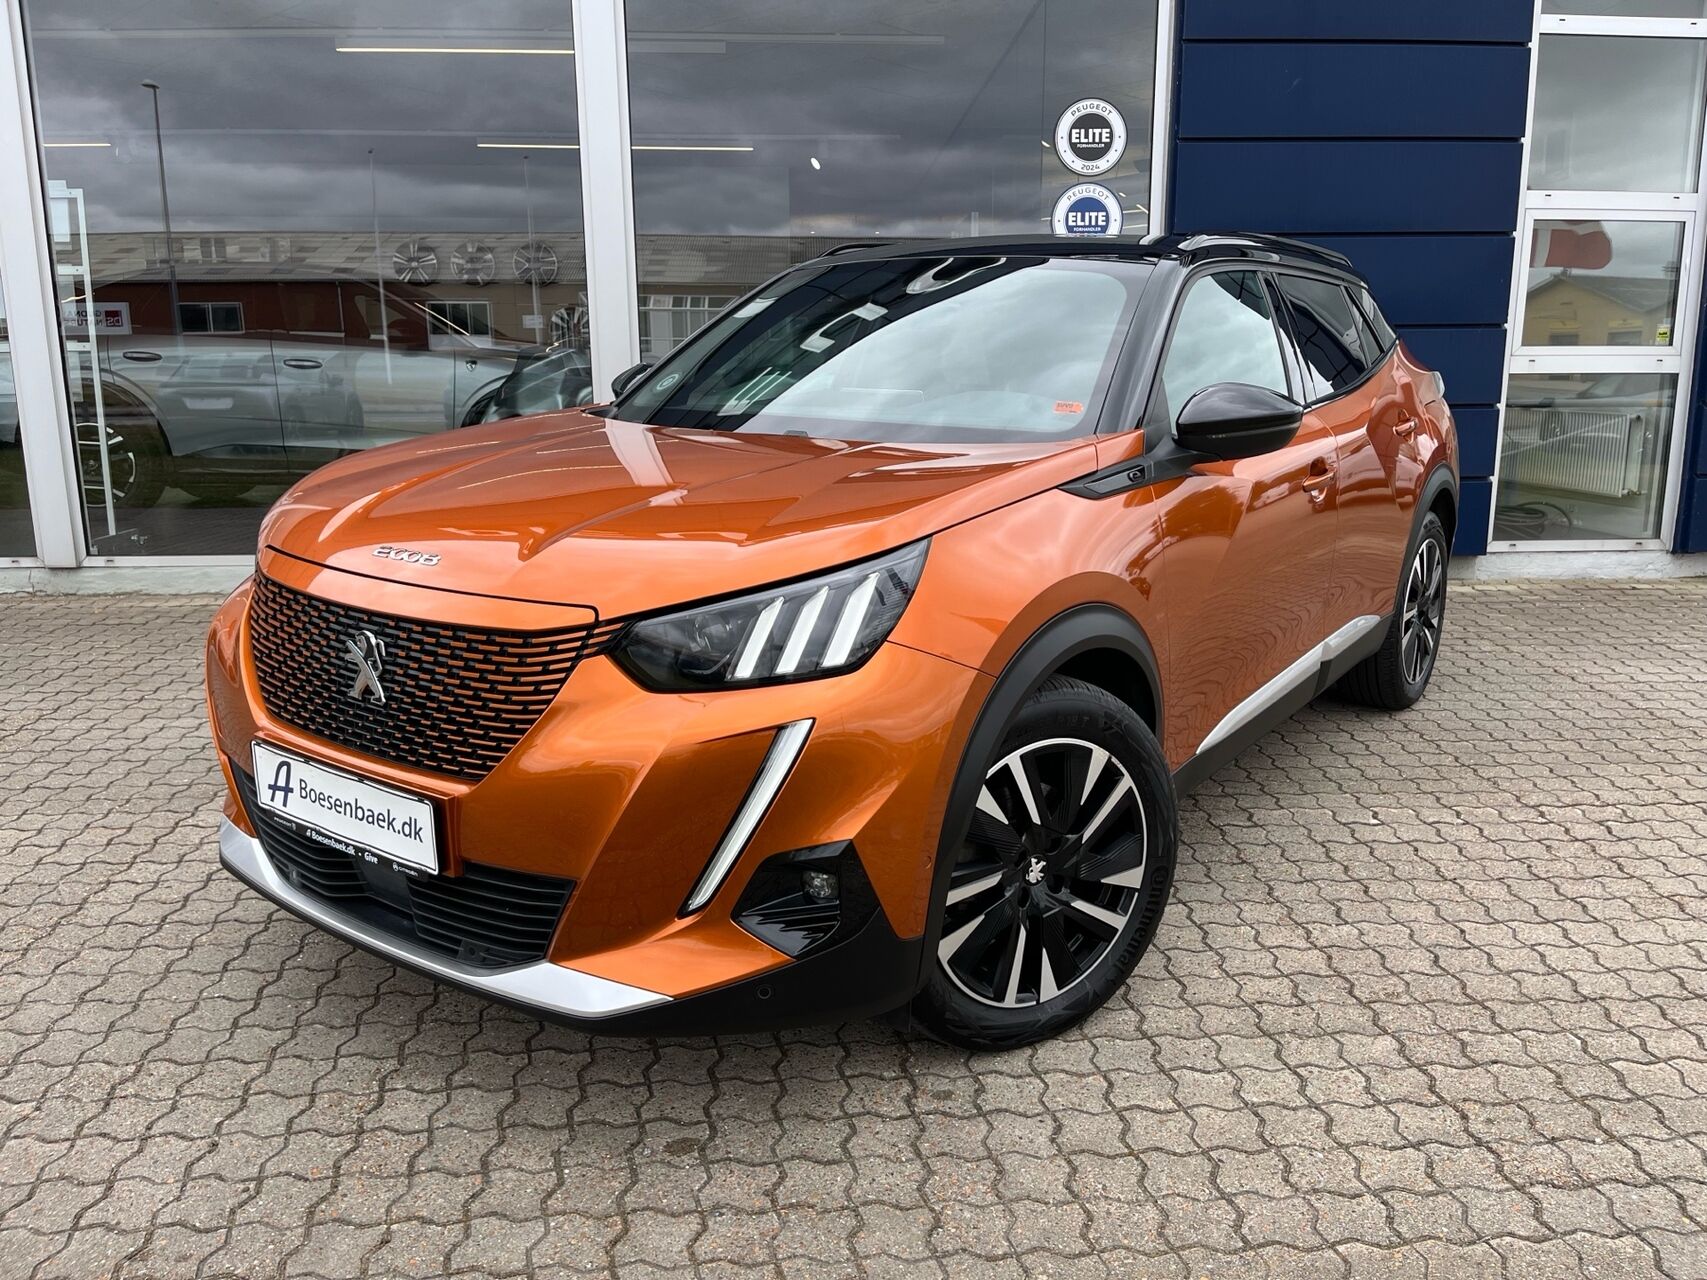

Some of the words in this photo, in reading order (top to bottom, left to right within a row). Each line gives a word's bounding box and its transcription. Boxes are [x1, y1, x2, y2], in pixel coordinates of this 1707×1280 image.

[1070, 102, 1113, 117] PEUGEOT
[1071, 128, 1111, 143] ELITE
[1080, 163, 1101, 171] 2024
[1066, 186, 1110, 202] PEUGEOT
[1068, 211, 1107, 226] ELITE
[299, 777, 424, 844] Boesenbaek.dk
[311, 830, 355, 856] Boesenbaek.dk
[364, 851, 379, 864] Give
[1115, 864, 1169, 974] Continental
